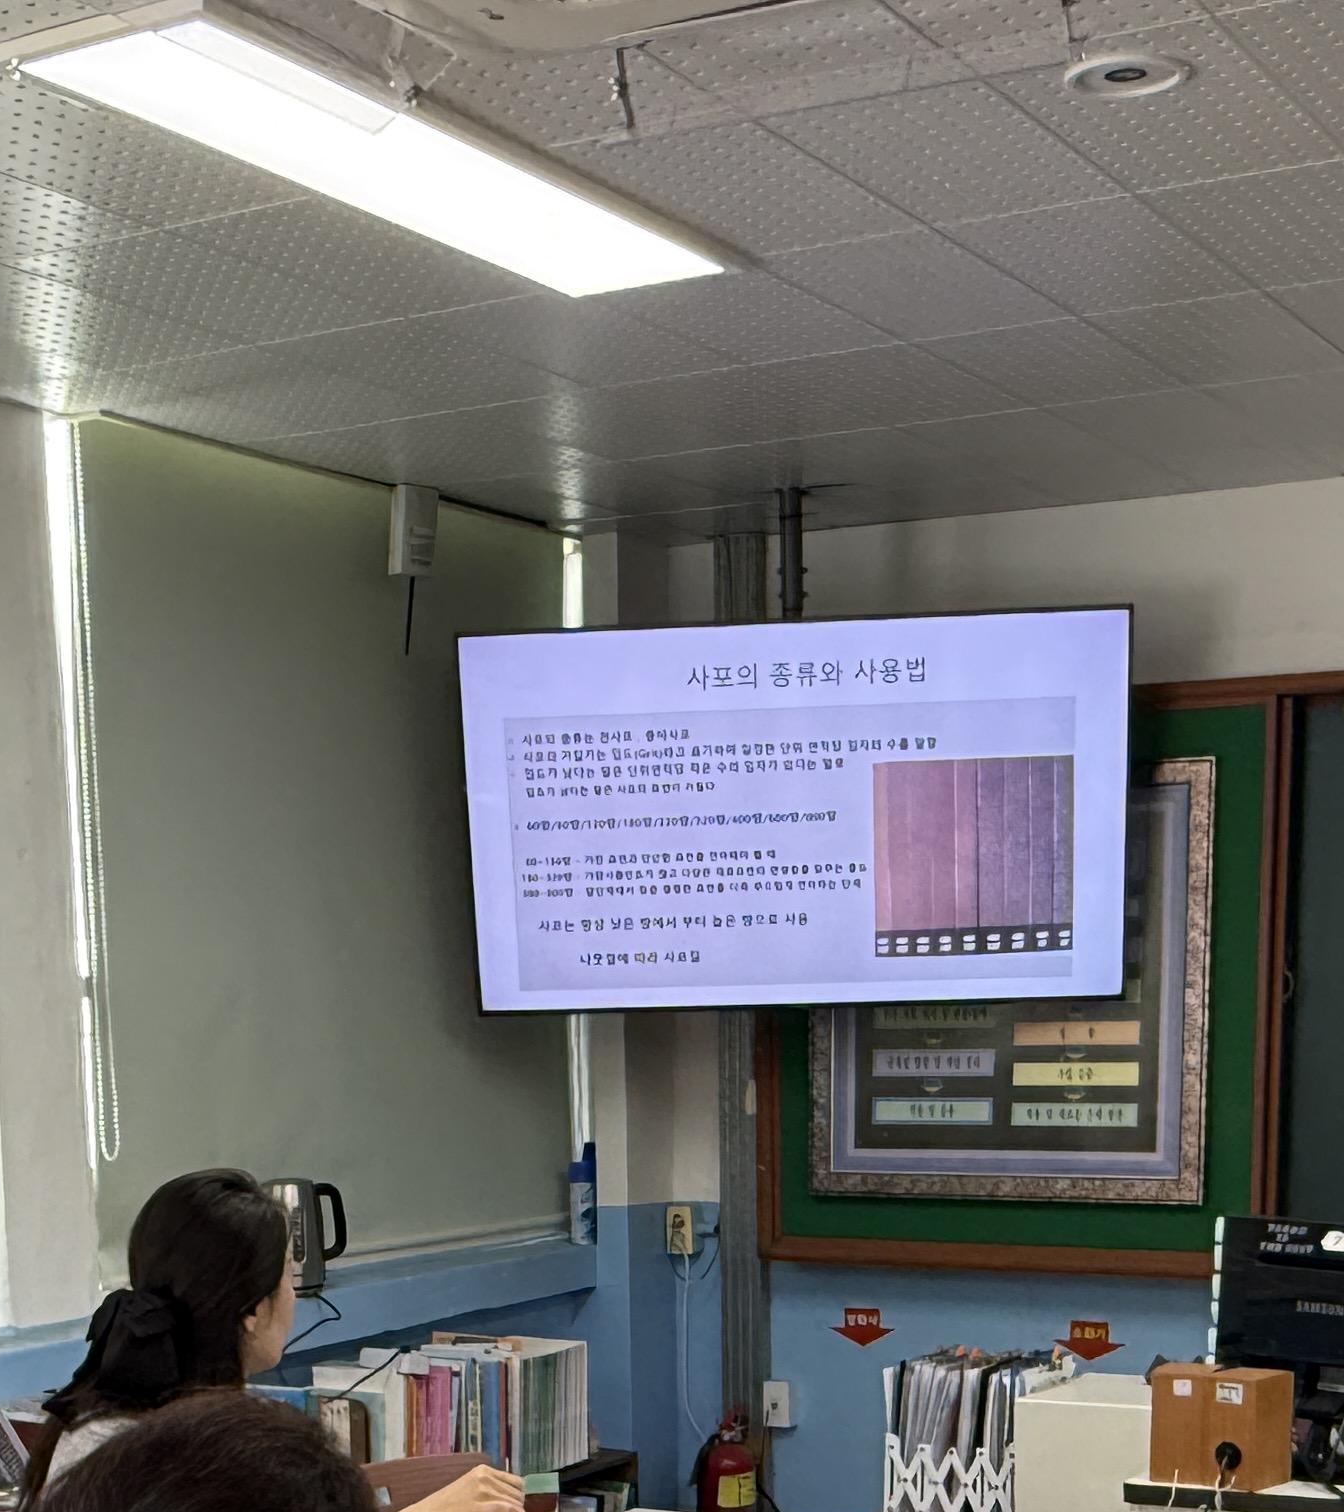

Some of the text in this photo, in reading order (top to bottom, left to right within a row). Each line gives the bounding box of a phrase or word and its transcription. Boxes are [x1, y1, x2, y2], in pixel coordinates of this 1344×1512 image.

[686, 656, 926, 692] 사포의 종류와 사용법
